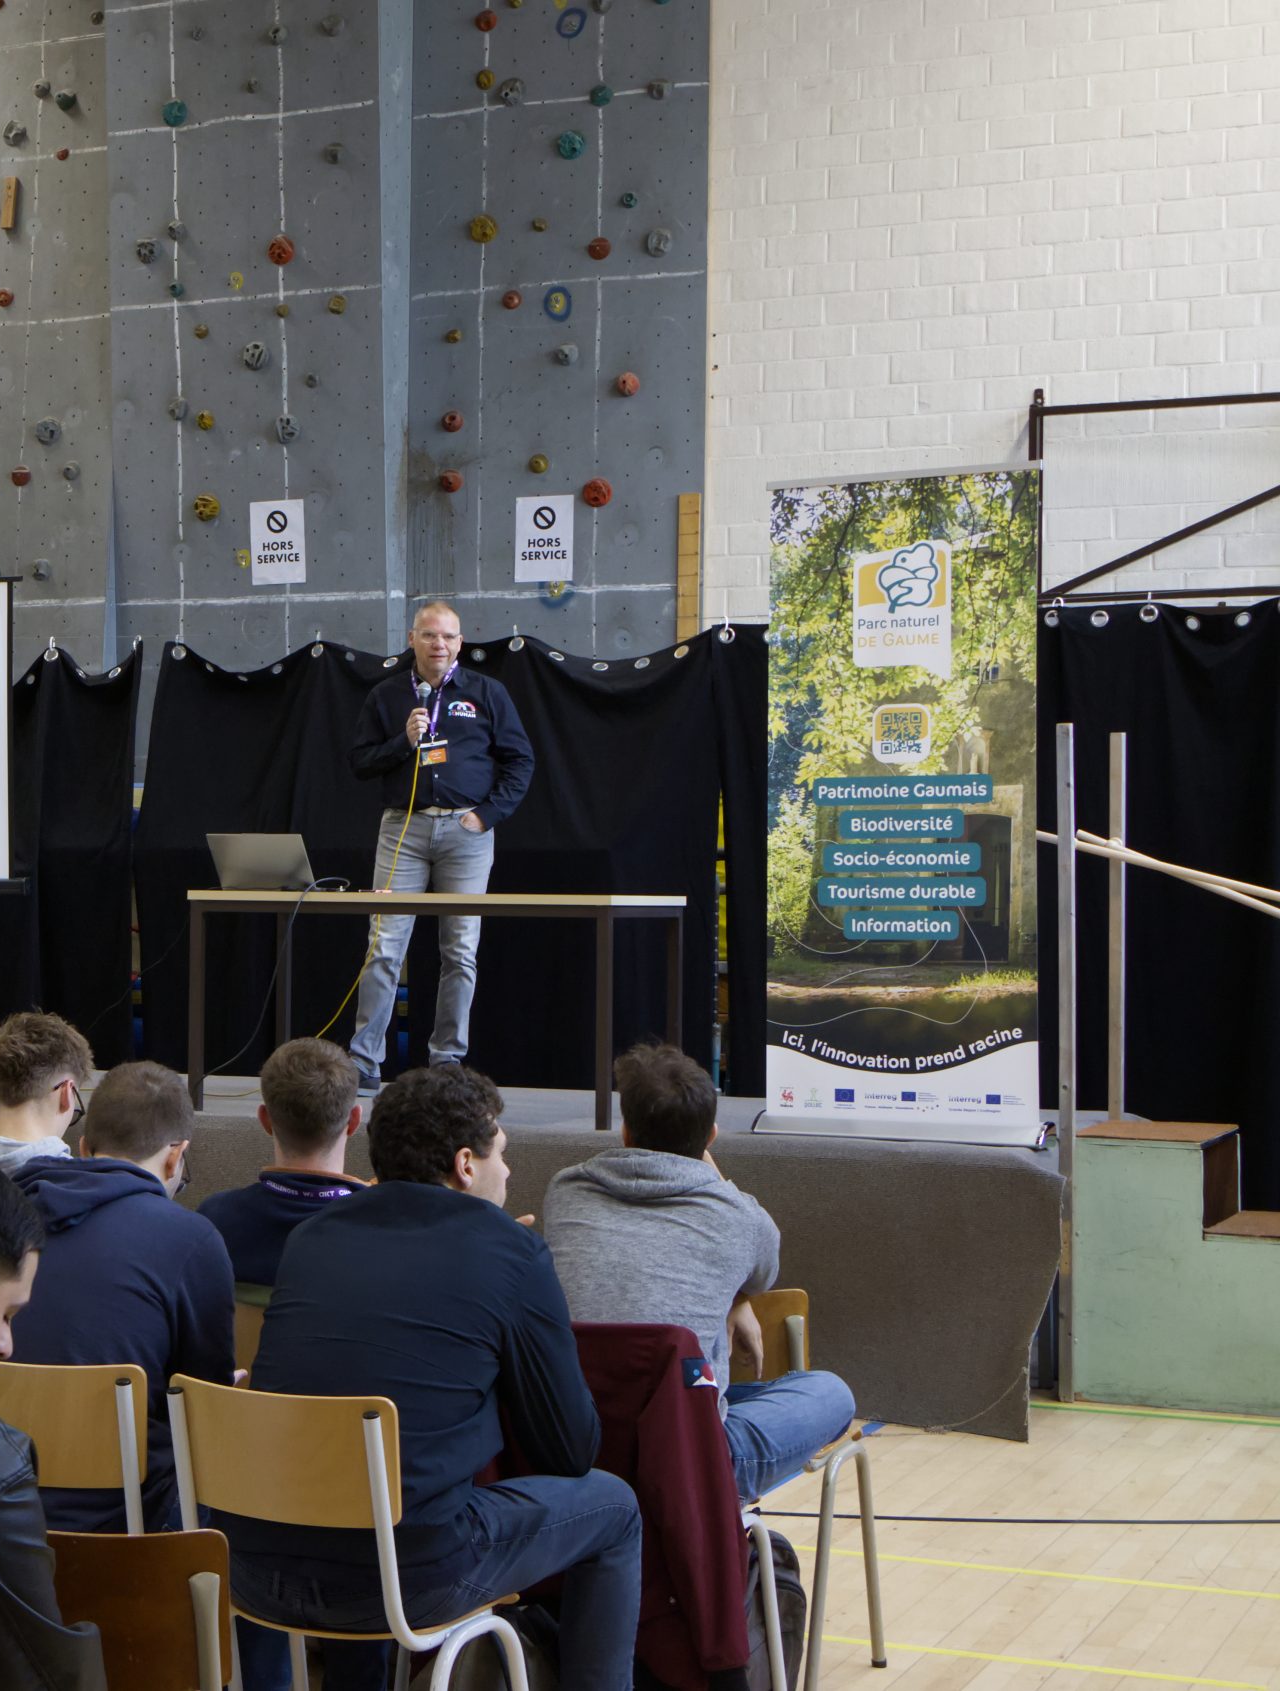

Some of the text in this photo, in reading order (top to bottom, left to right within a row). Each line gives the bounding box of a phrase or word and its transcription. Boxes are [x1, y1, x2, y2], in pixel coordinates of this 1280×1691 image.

[262, 540, 294, 552] HORS
[527, 537, 562, 549] HORS
[257, 552, 301, 565] SERVICE
[521, 549, 568, 562] SERVICE
[857, 614, 941, 631] Parc naturel
[857, 632, 941, 649] DE GAUME
[818, 782, 988, 800] Patrimoine Gaumais
[850, 815, 954, 832] Biodiversité
[833, 850, 971, 867] Socio-économie
[827, 883, 977, 900] Tourisme durable
[851, 917, 952, 934] Information
[782, 1027, 1024, 1071] Ici, l'innovation prend racine
